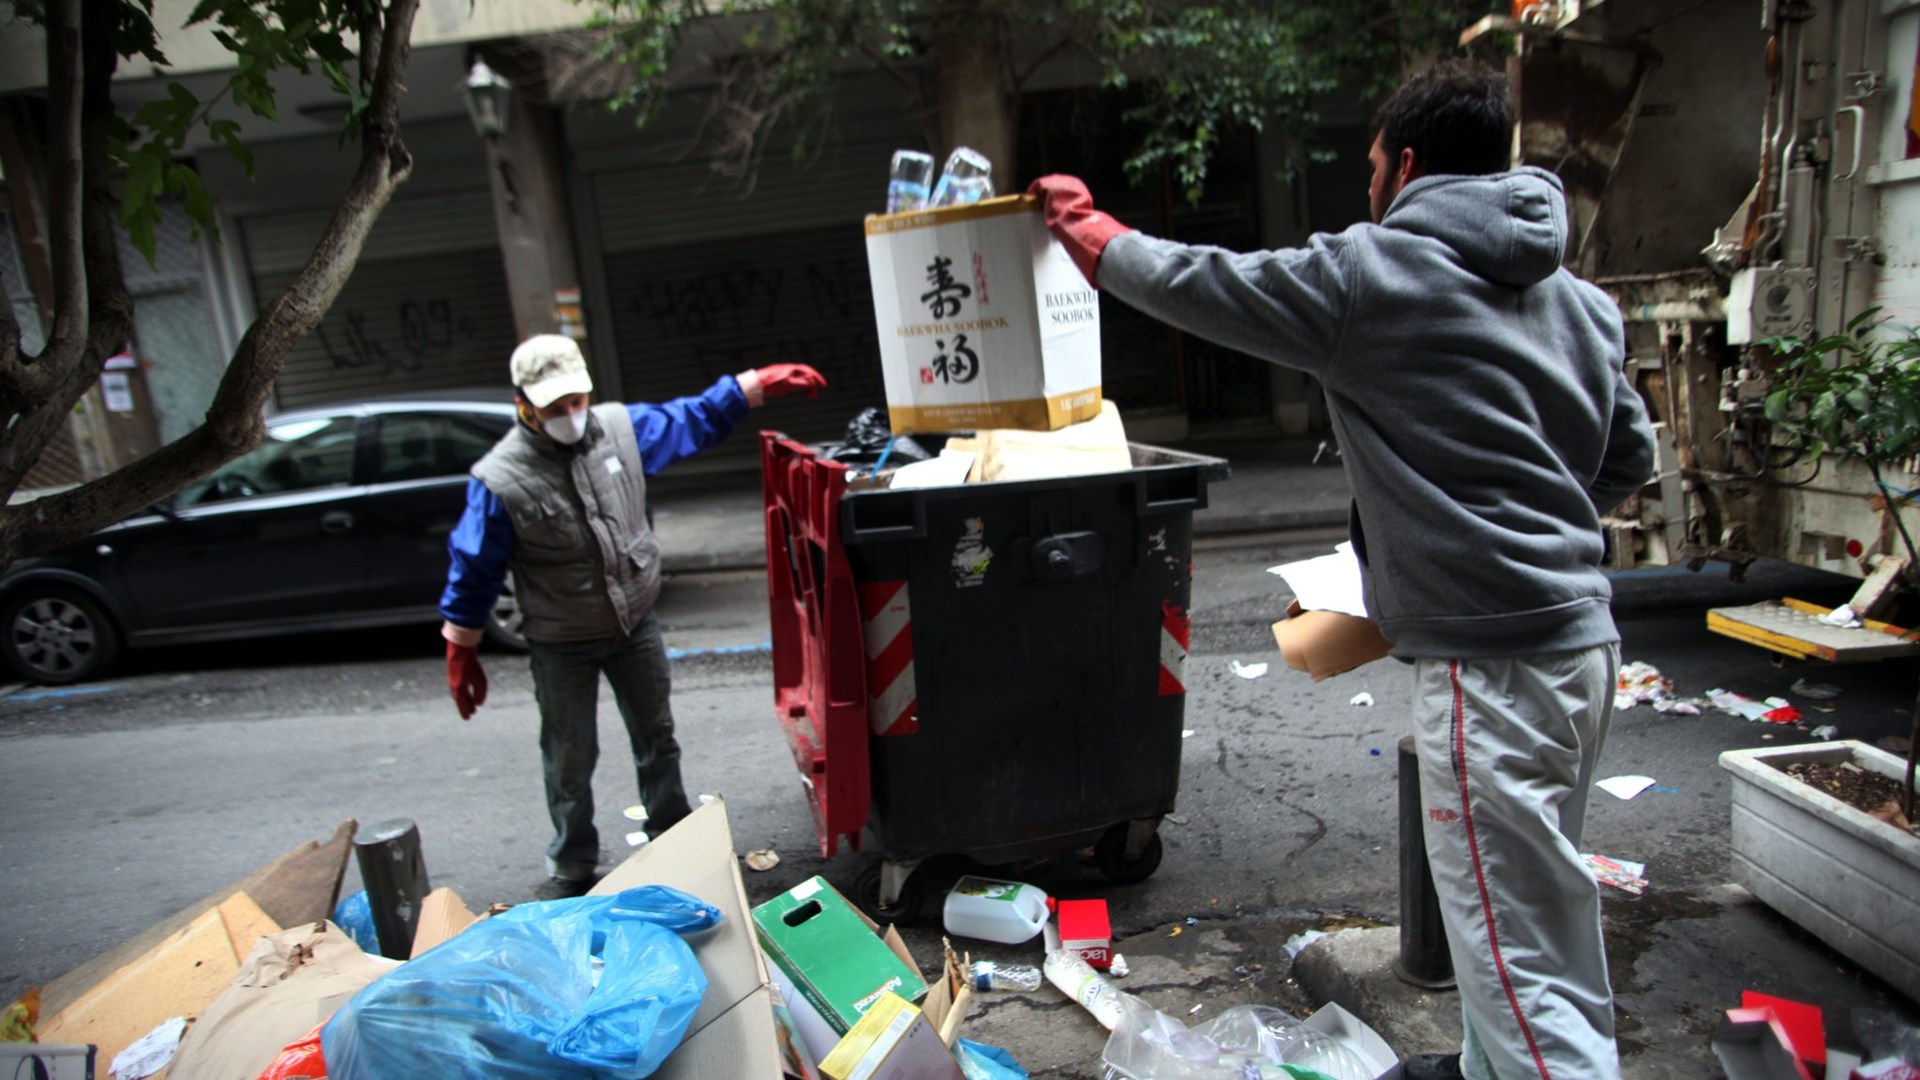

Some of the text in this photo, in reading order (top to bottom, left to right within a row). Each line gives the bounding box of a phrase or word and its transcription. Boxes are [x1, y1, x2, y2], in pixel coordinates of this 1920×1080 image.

[1051, 308, 1095, 324] SOOBOK
[897, 315, 1009, 337] BAEKWHA SOOBOK
